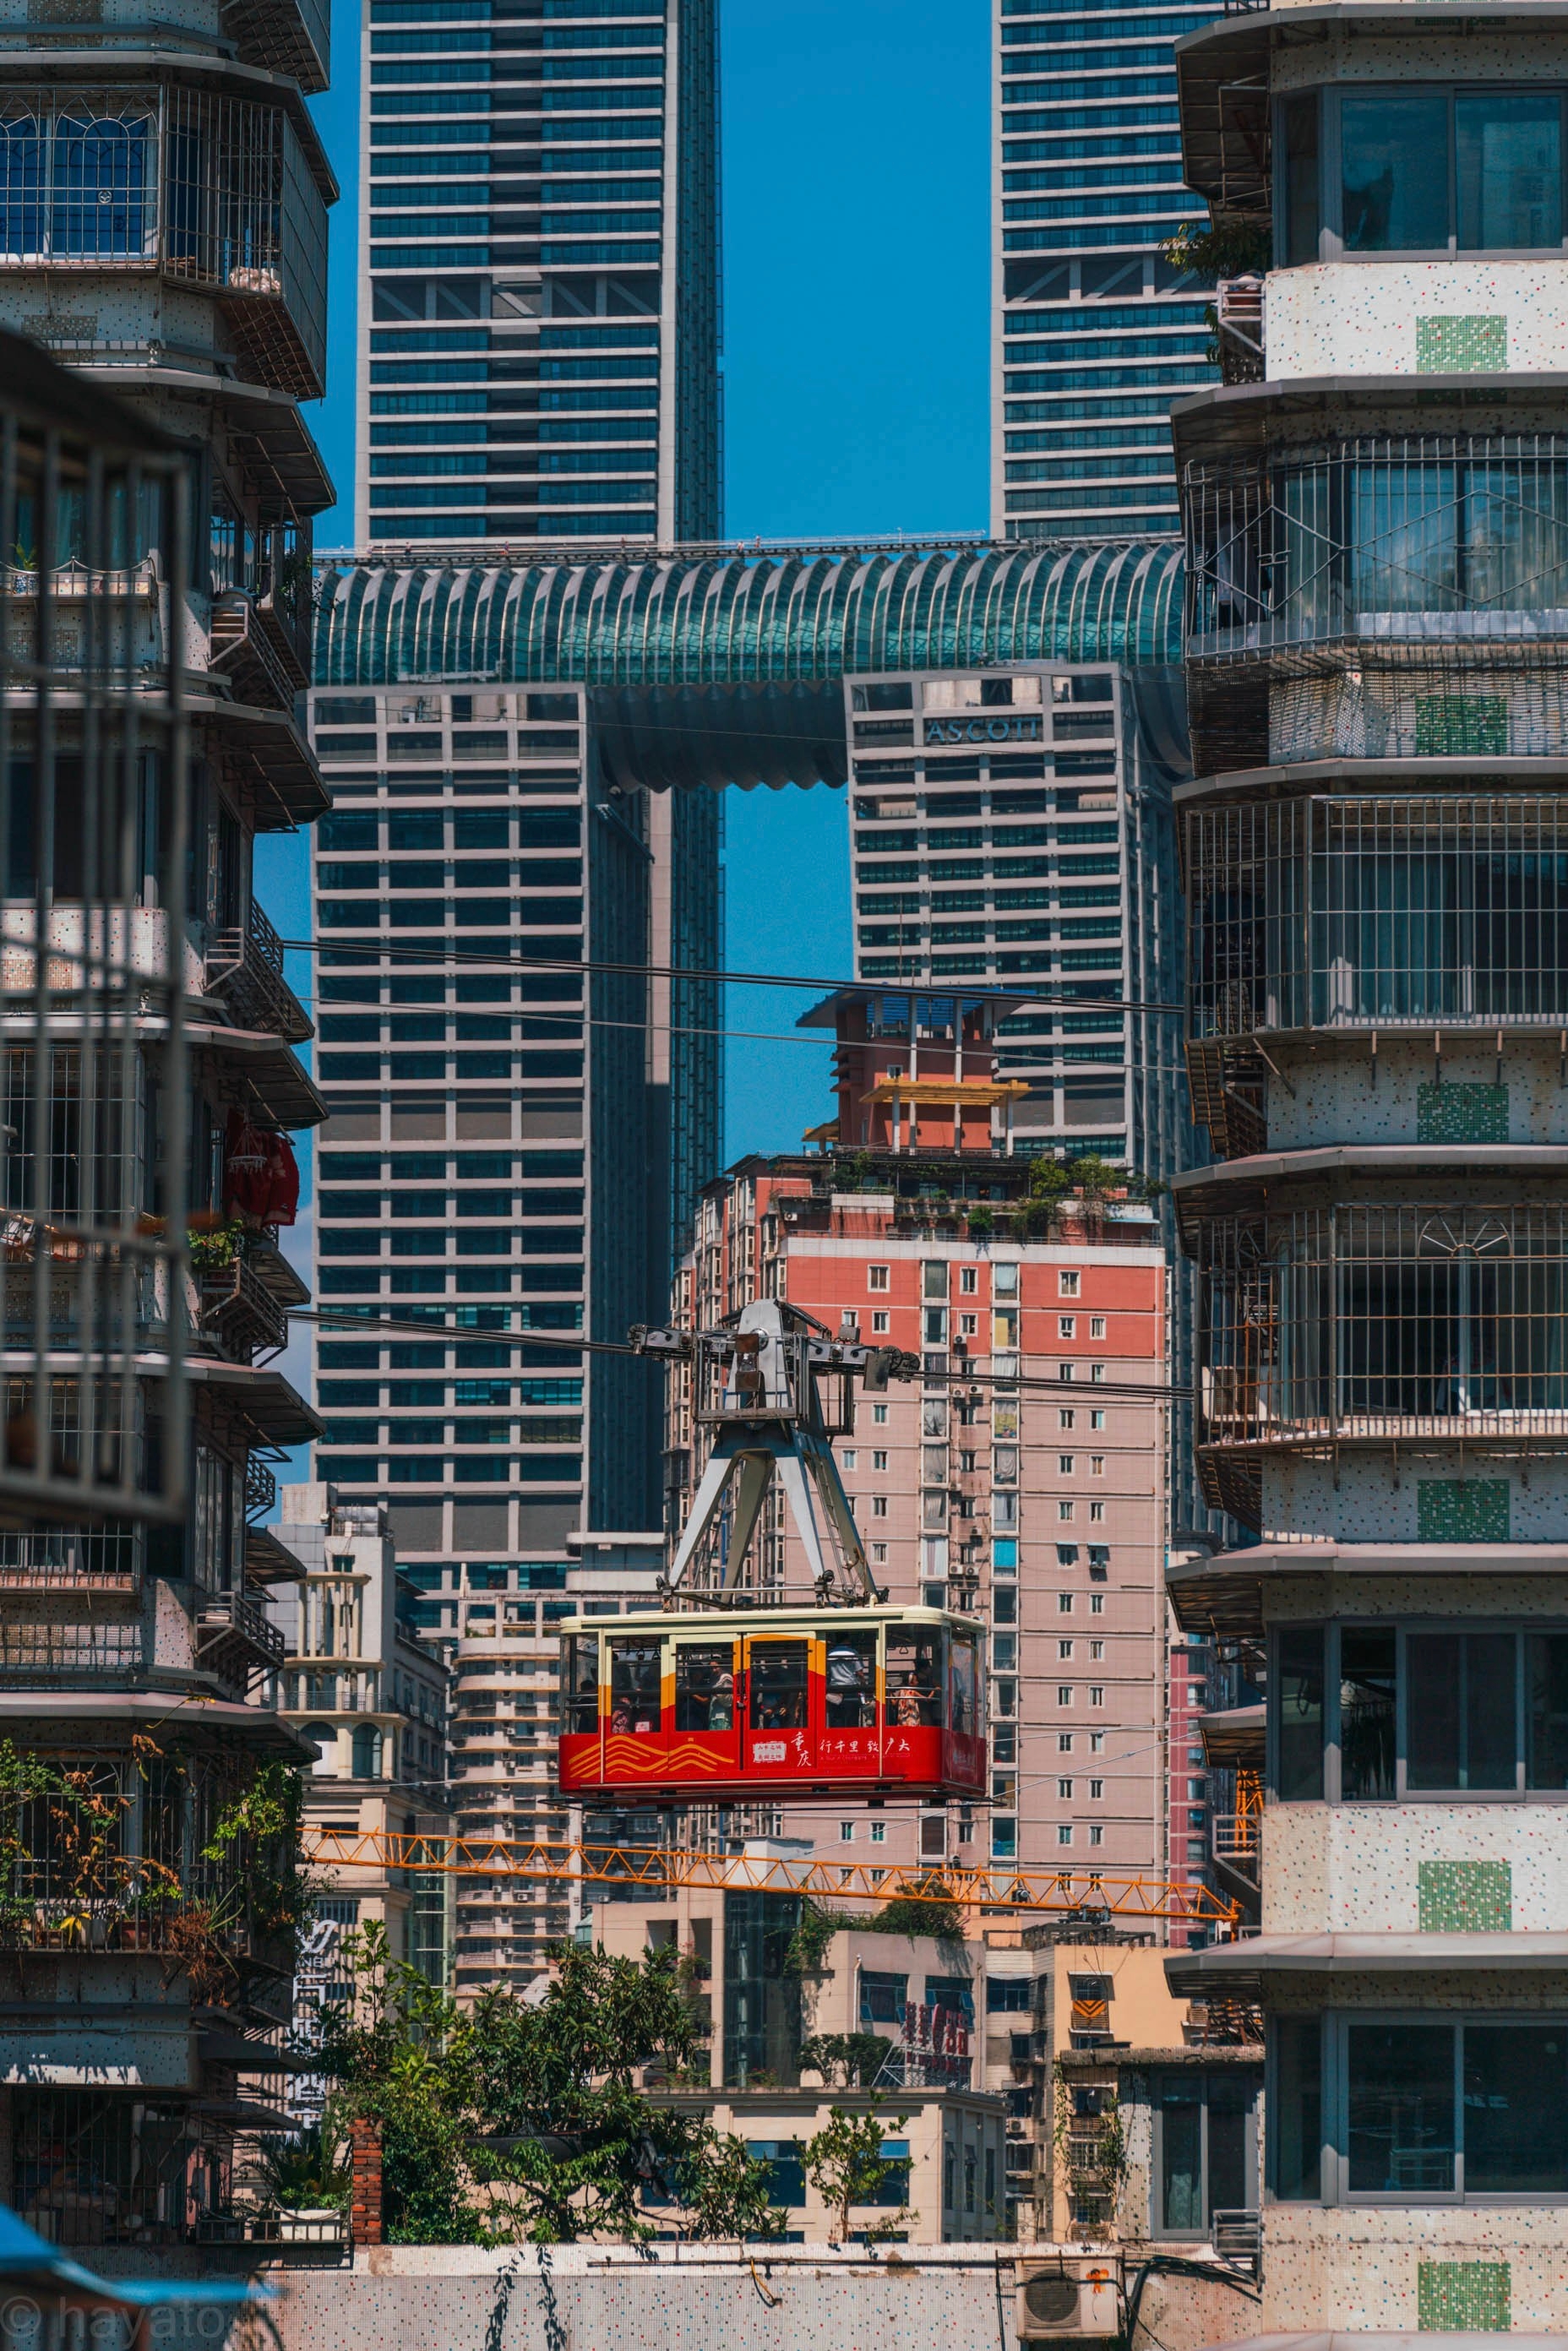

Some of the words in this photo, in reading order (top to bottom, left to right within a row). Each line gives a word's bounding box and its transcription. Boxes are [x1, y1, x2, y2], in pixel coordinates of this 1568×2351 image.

[926, 716, 1040, 743] ASCOTT
[791, 1731, 812, 1767] 重庆
[819, 1739, 859, 1754] 行千里
